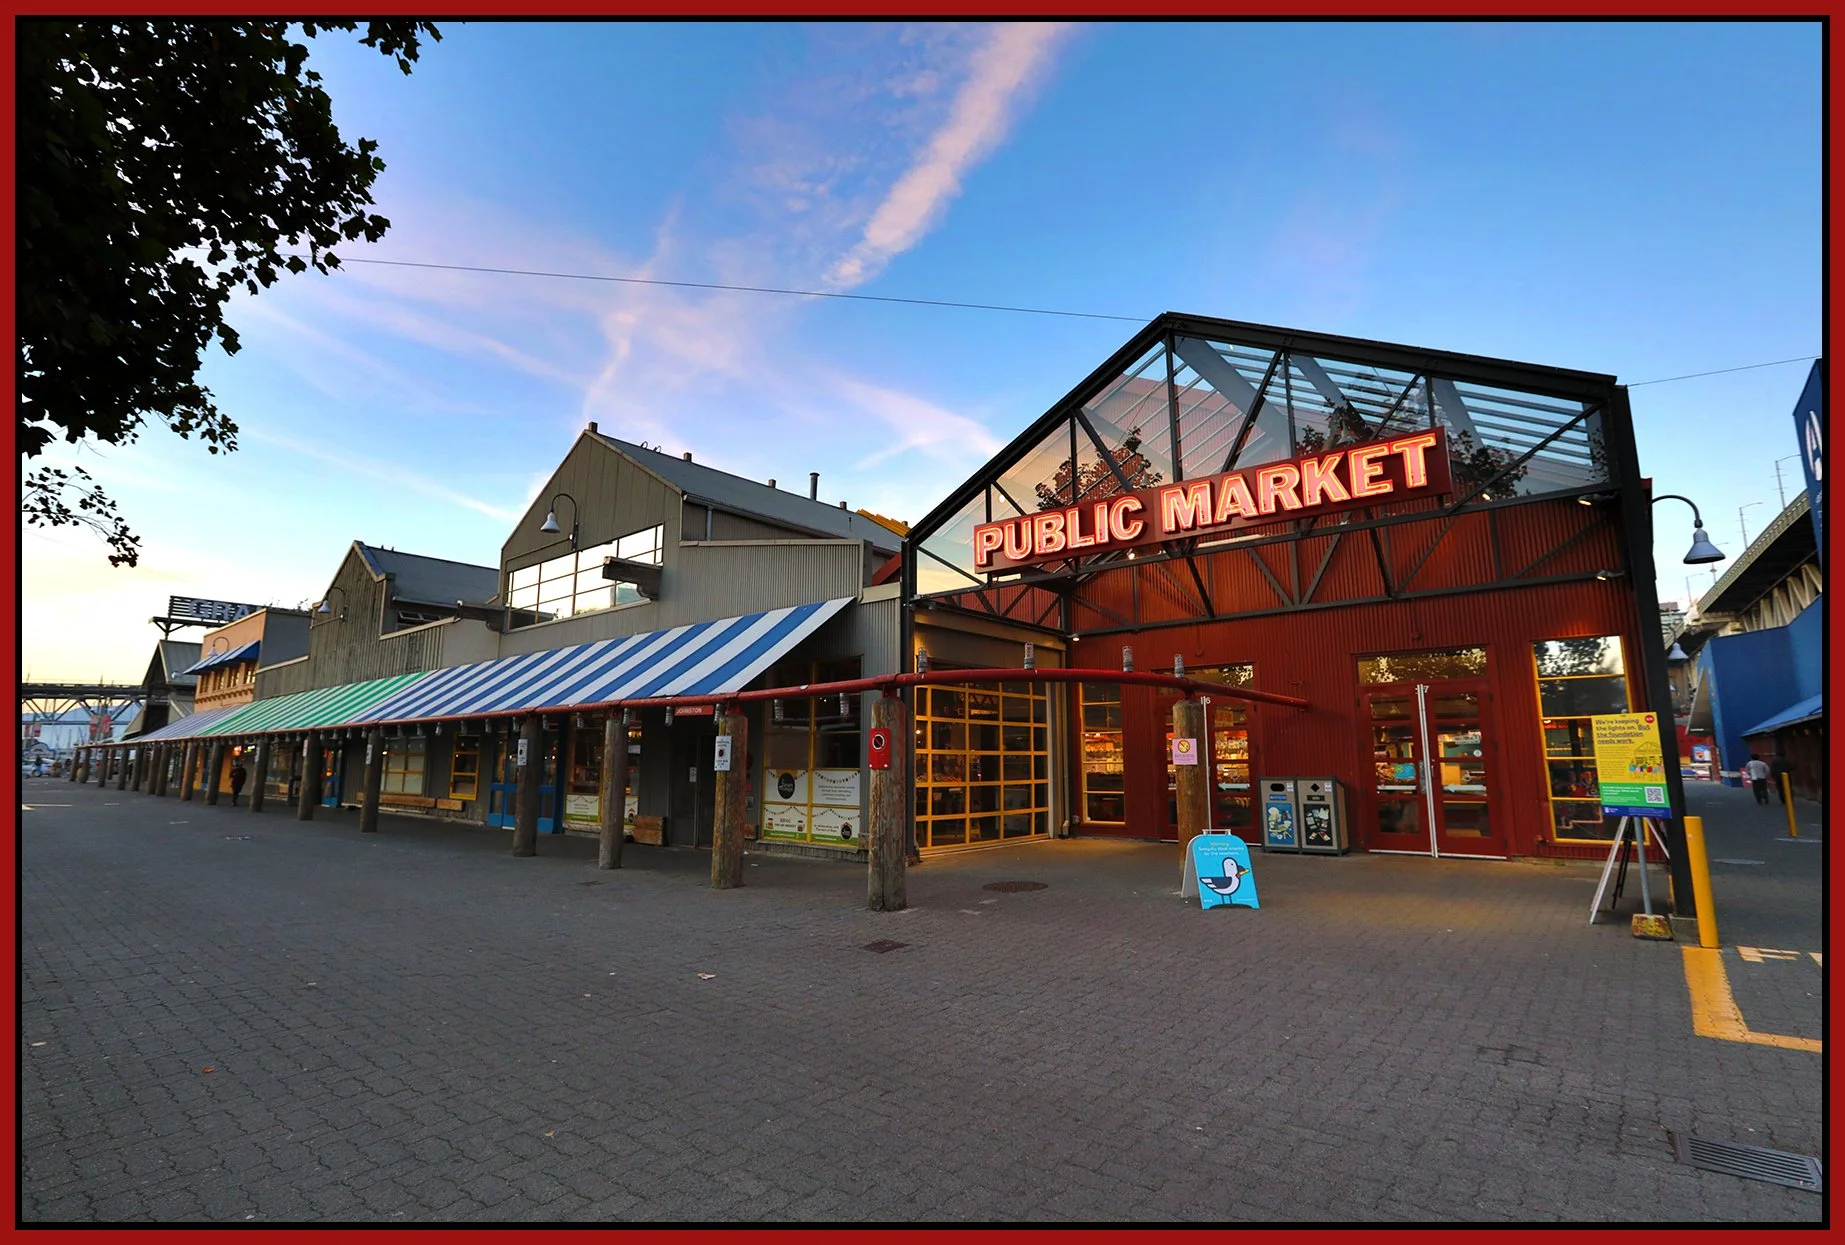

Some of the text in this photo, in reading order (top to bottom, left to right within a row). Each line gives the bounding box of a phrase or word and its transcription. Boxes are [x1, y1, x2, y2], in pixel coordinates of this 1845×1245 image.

[974, 432, 1438, 568] PUBLIC MARKET
[188, 599, 262, 621] GRA
[676, 707, 703, 715] JOHNSTON
[1608, 731, 1643, 739] foundation
